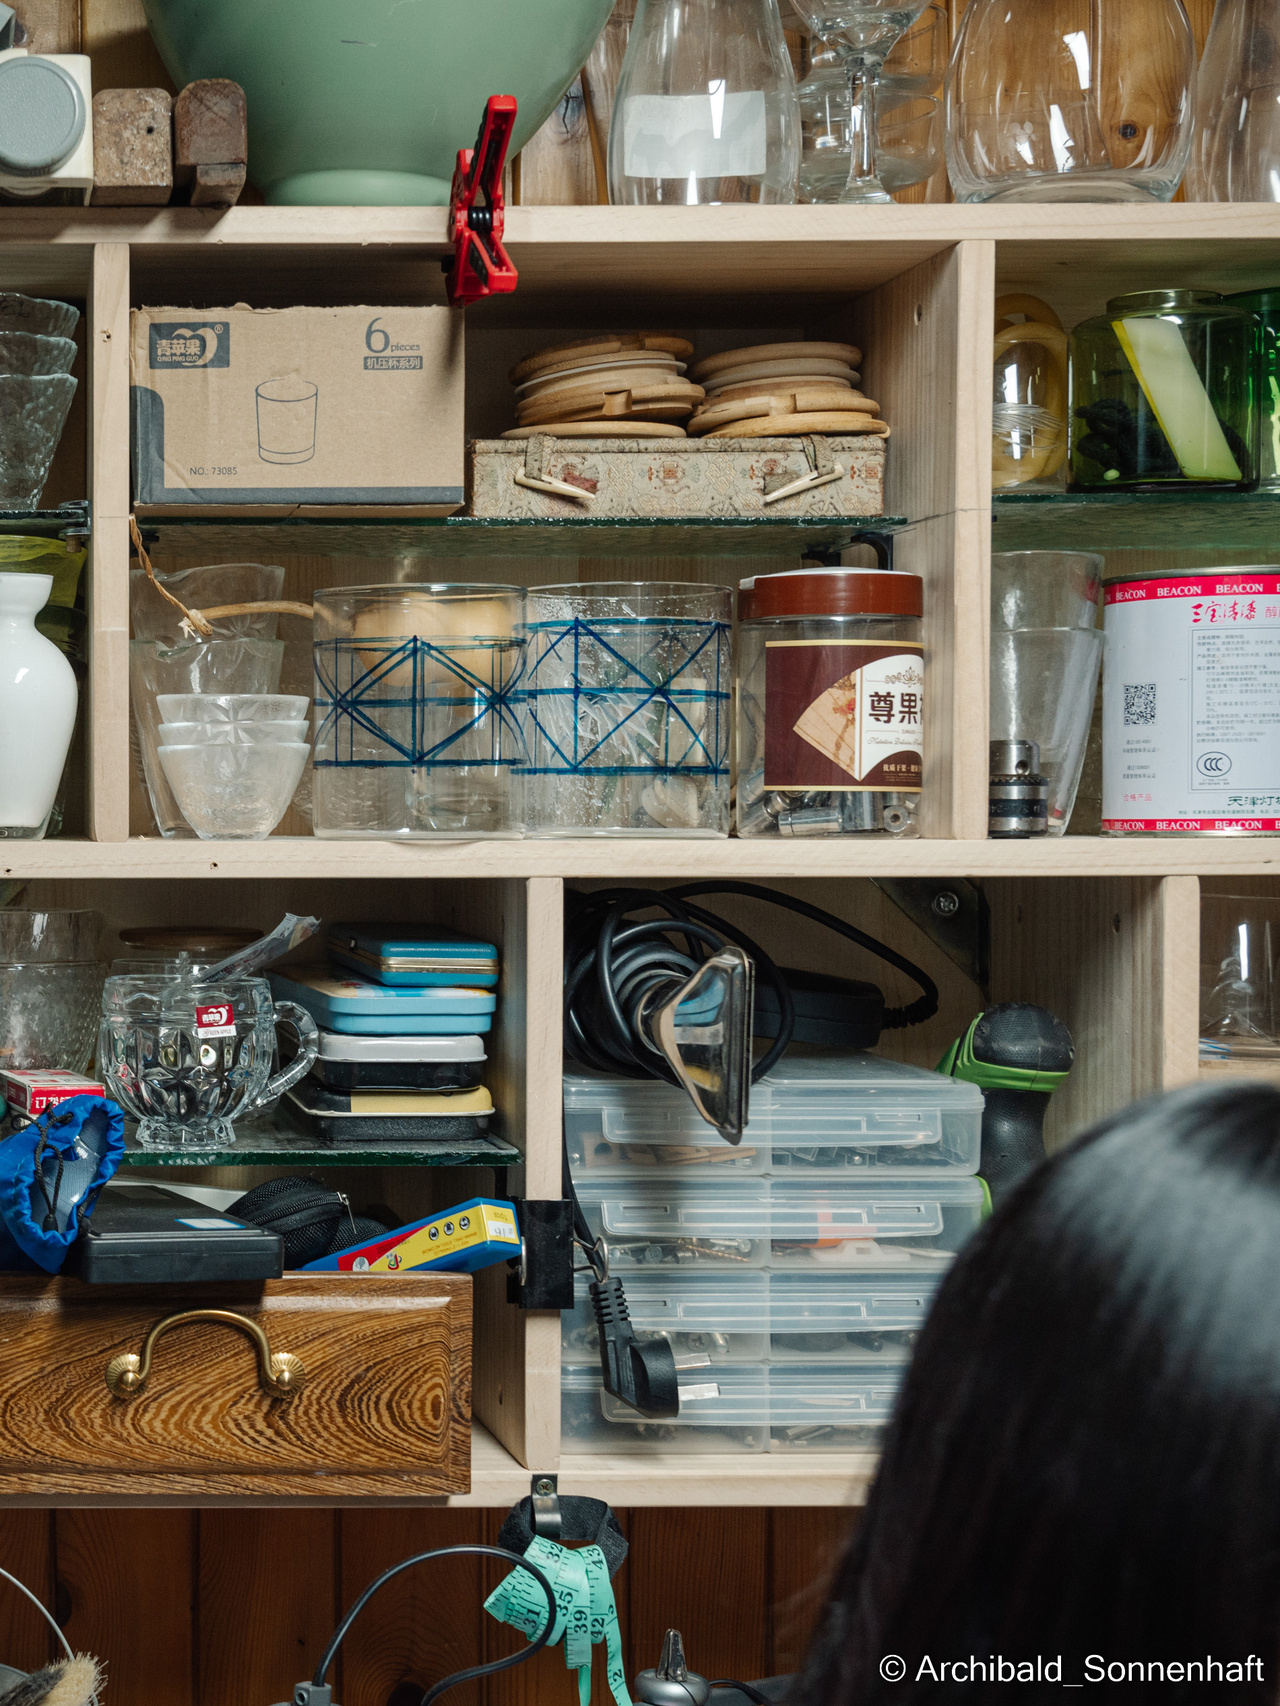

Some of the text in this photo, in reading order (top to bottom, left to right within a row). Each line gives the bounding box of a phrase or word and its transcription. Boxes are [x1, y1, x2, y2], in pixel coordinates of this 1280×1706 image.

[365, 316, 421, 354] 6 pieces
[156, 338, 201, 356] 青苹果
[366, 357, 421, 369] 机压杯系列
[211, 466, 238, 476] 73085
[1115, 589, 1146, 601] BEACON
[1157, 585, 1202, 597] BEACON
[1215, 583, 1263, 594] BEACON
[869, 691, 923, 725] 尊果
[1114, 820, 1262, 830] BEACON BEACON BEACON
[546, 1543, 564, 1563] 32
[586, 1547, 605, 1570] 43
[556, 1591, 574, 1617] 35
[523, 1608, 542, 1629] 31
[573, 1609, 589, 1634] 39
[590, 1616, 605, 1640] 42
[613, 1668, 623, 1683] 2
